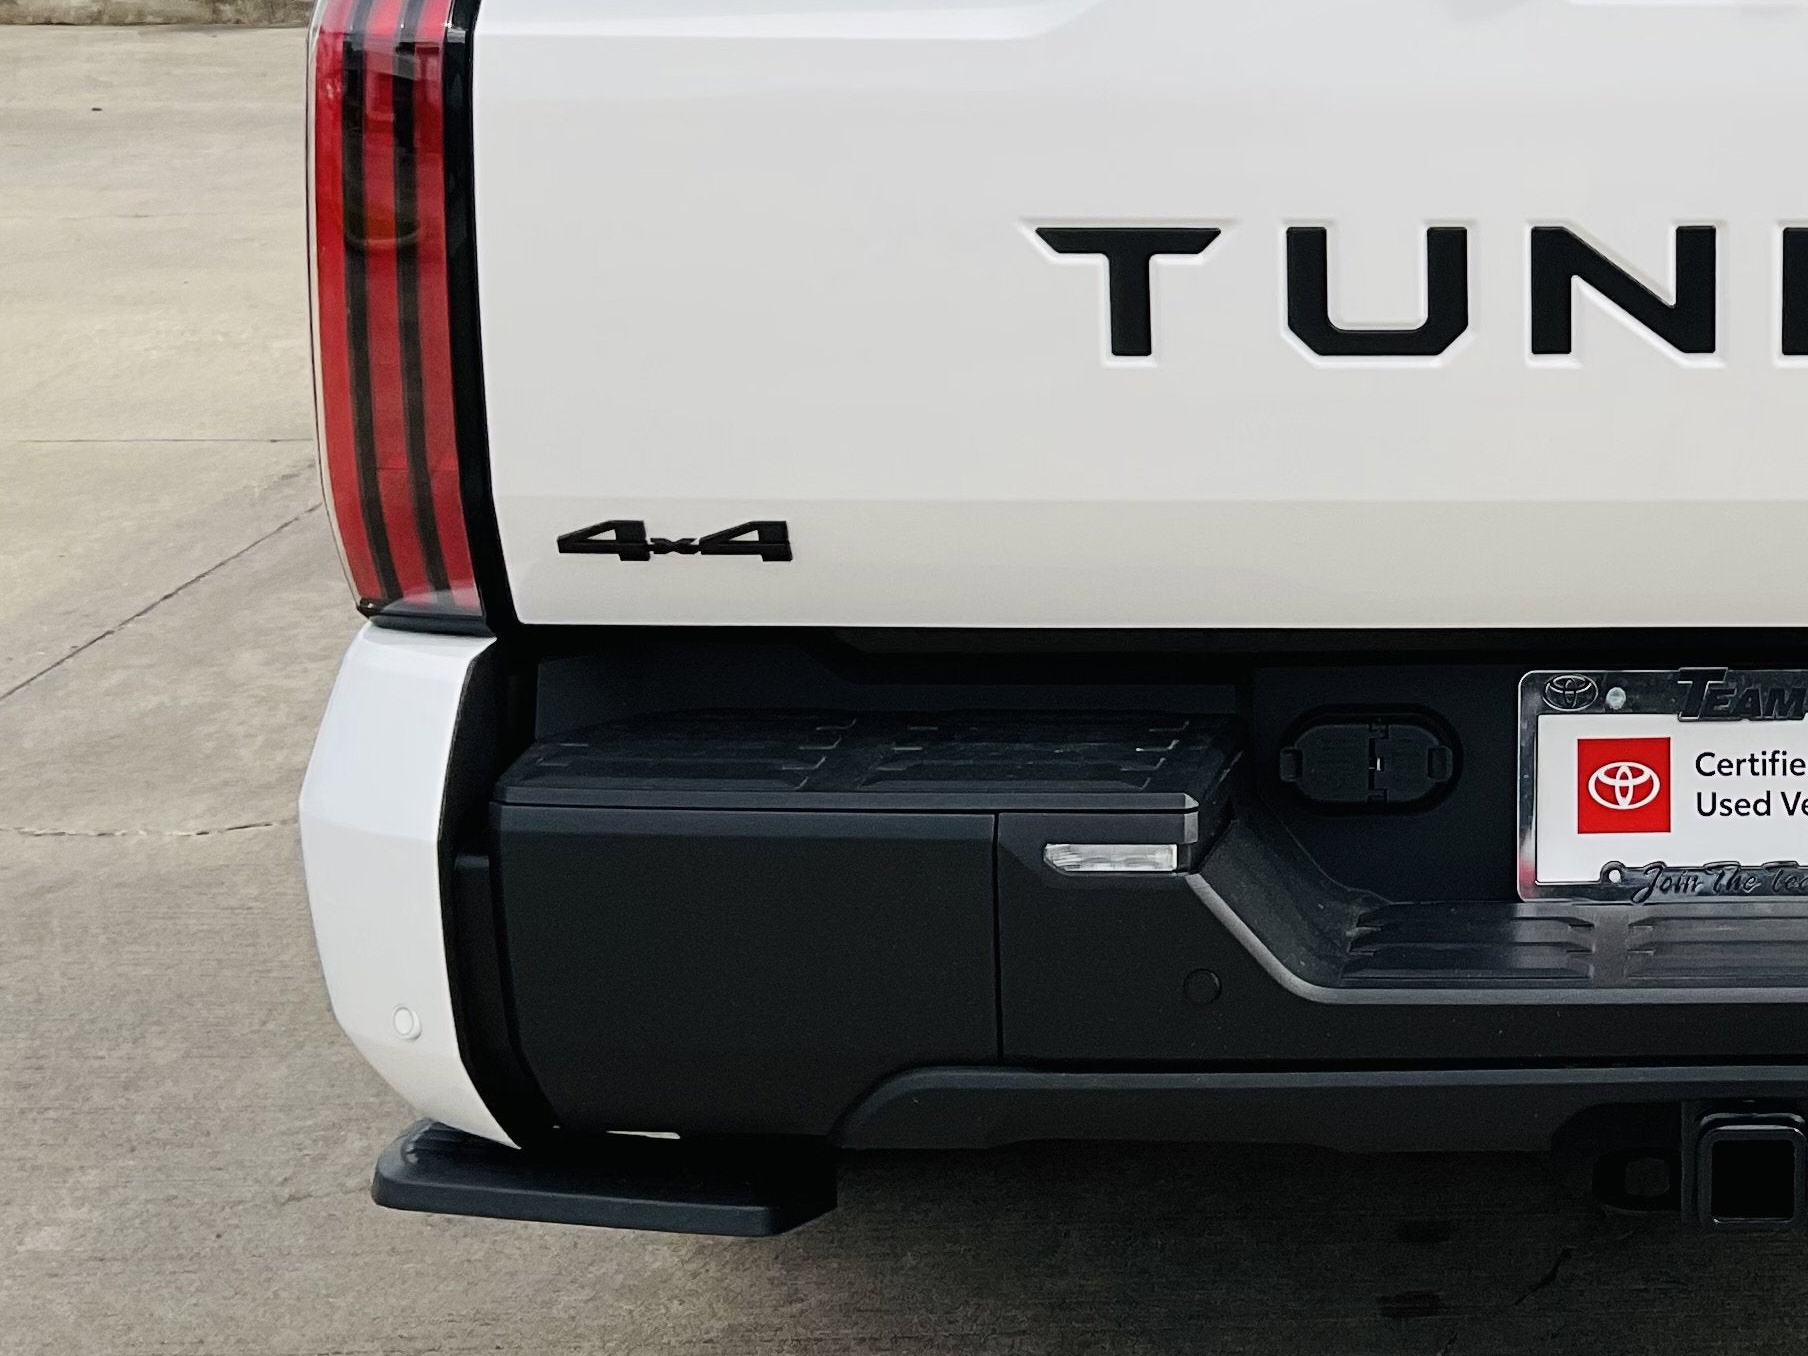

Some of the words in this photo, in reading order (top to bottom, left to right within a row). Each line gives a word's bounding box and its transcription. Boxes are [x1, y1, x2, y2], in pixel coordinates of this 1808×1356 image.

[1677, 667, 1808, 722] TEAM
[1696, 790, 1771, 817] Used
[1631, 861, 1702, 904] Join
[1703, 861, 1761, 895] The
